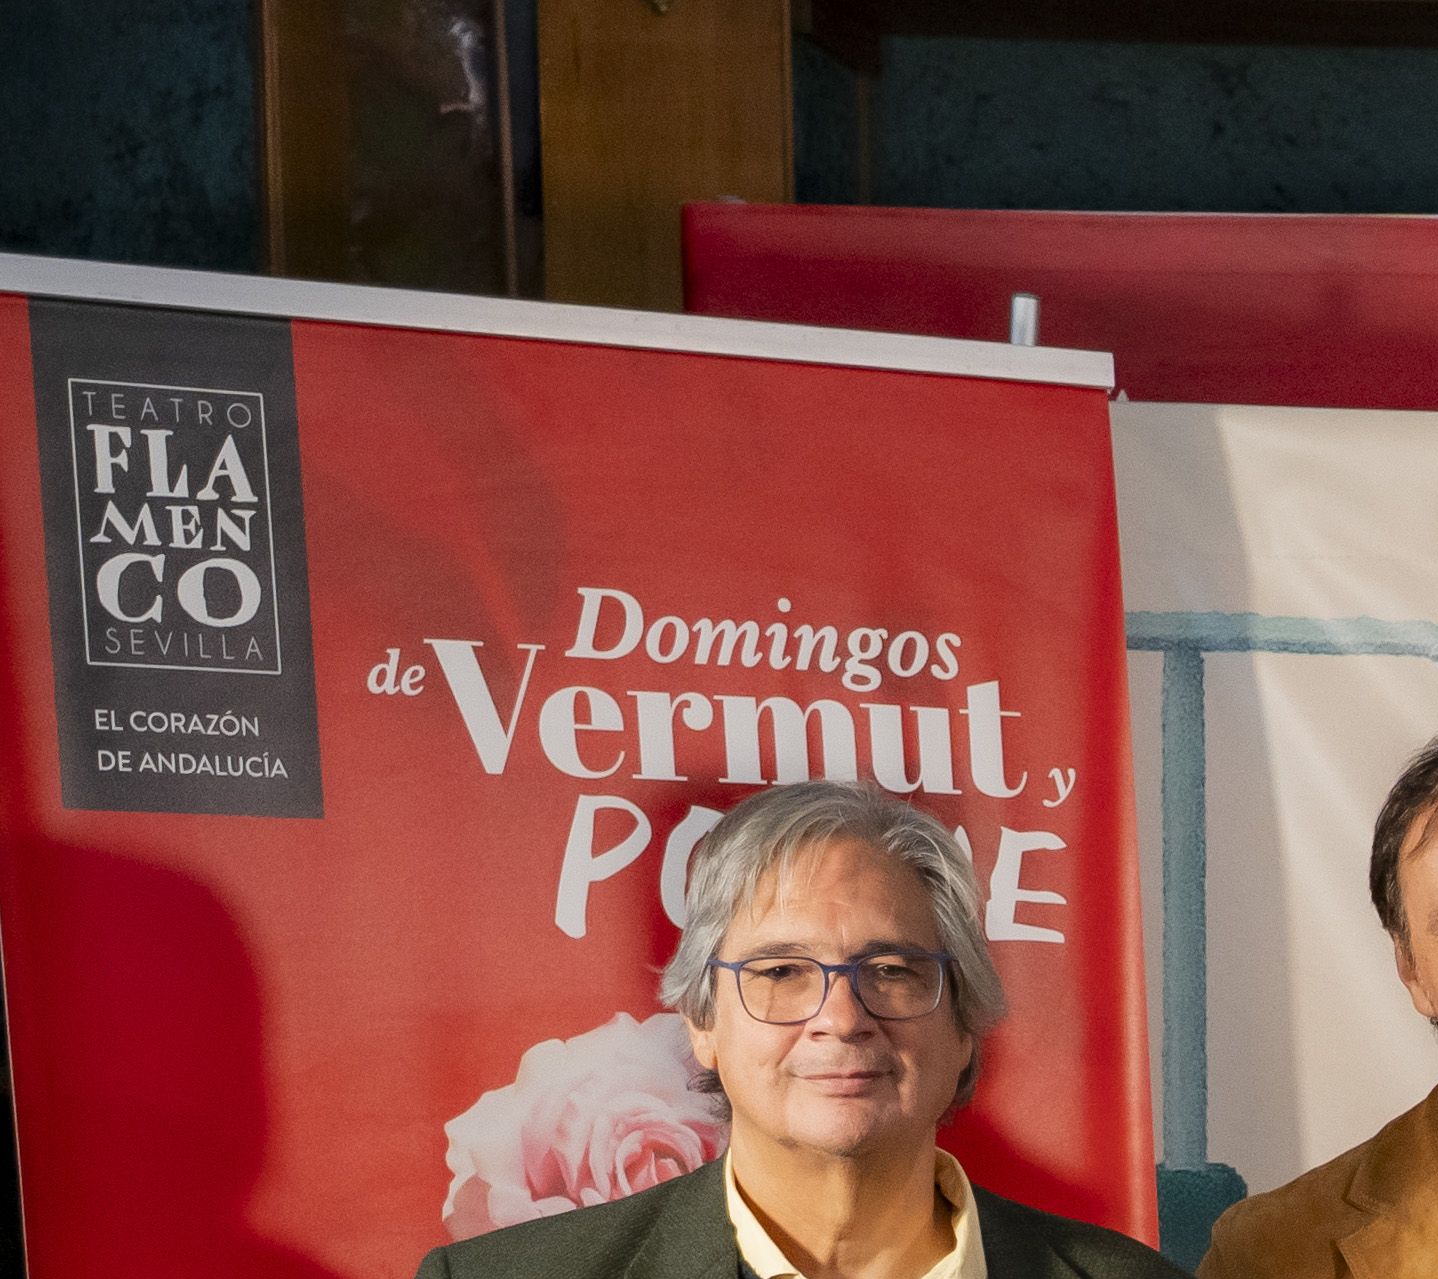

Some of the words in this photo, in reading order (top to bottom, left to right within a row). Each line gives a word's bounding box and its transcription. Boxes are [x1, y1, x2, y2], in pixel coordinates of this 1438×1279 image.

[82, 391, 253, 429] TEATRO
[86, 423, 259, 503] FLA
[89, 500, 257, 552] MEN
[96, 552, 262, 628] CO
[104, 627, 264, 661] SEVILLA
[565, 586, 962, 693] Domingos
[94, 709, 124, 732] EL
[129, 707, 260, 737] CORAZÓN
[366, 648, 426, 697] de
[423, 637, 1029, 799] Vermut
[1042, 766, 1077, 808] y
[98, 750, 132, 773] DE
[138, 750, 289, 779] ANDALUCÍA
